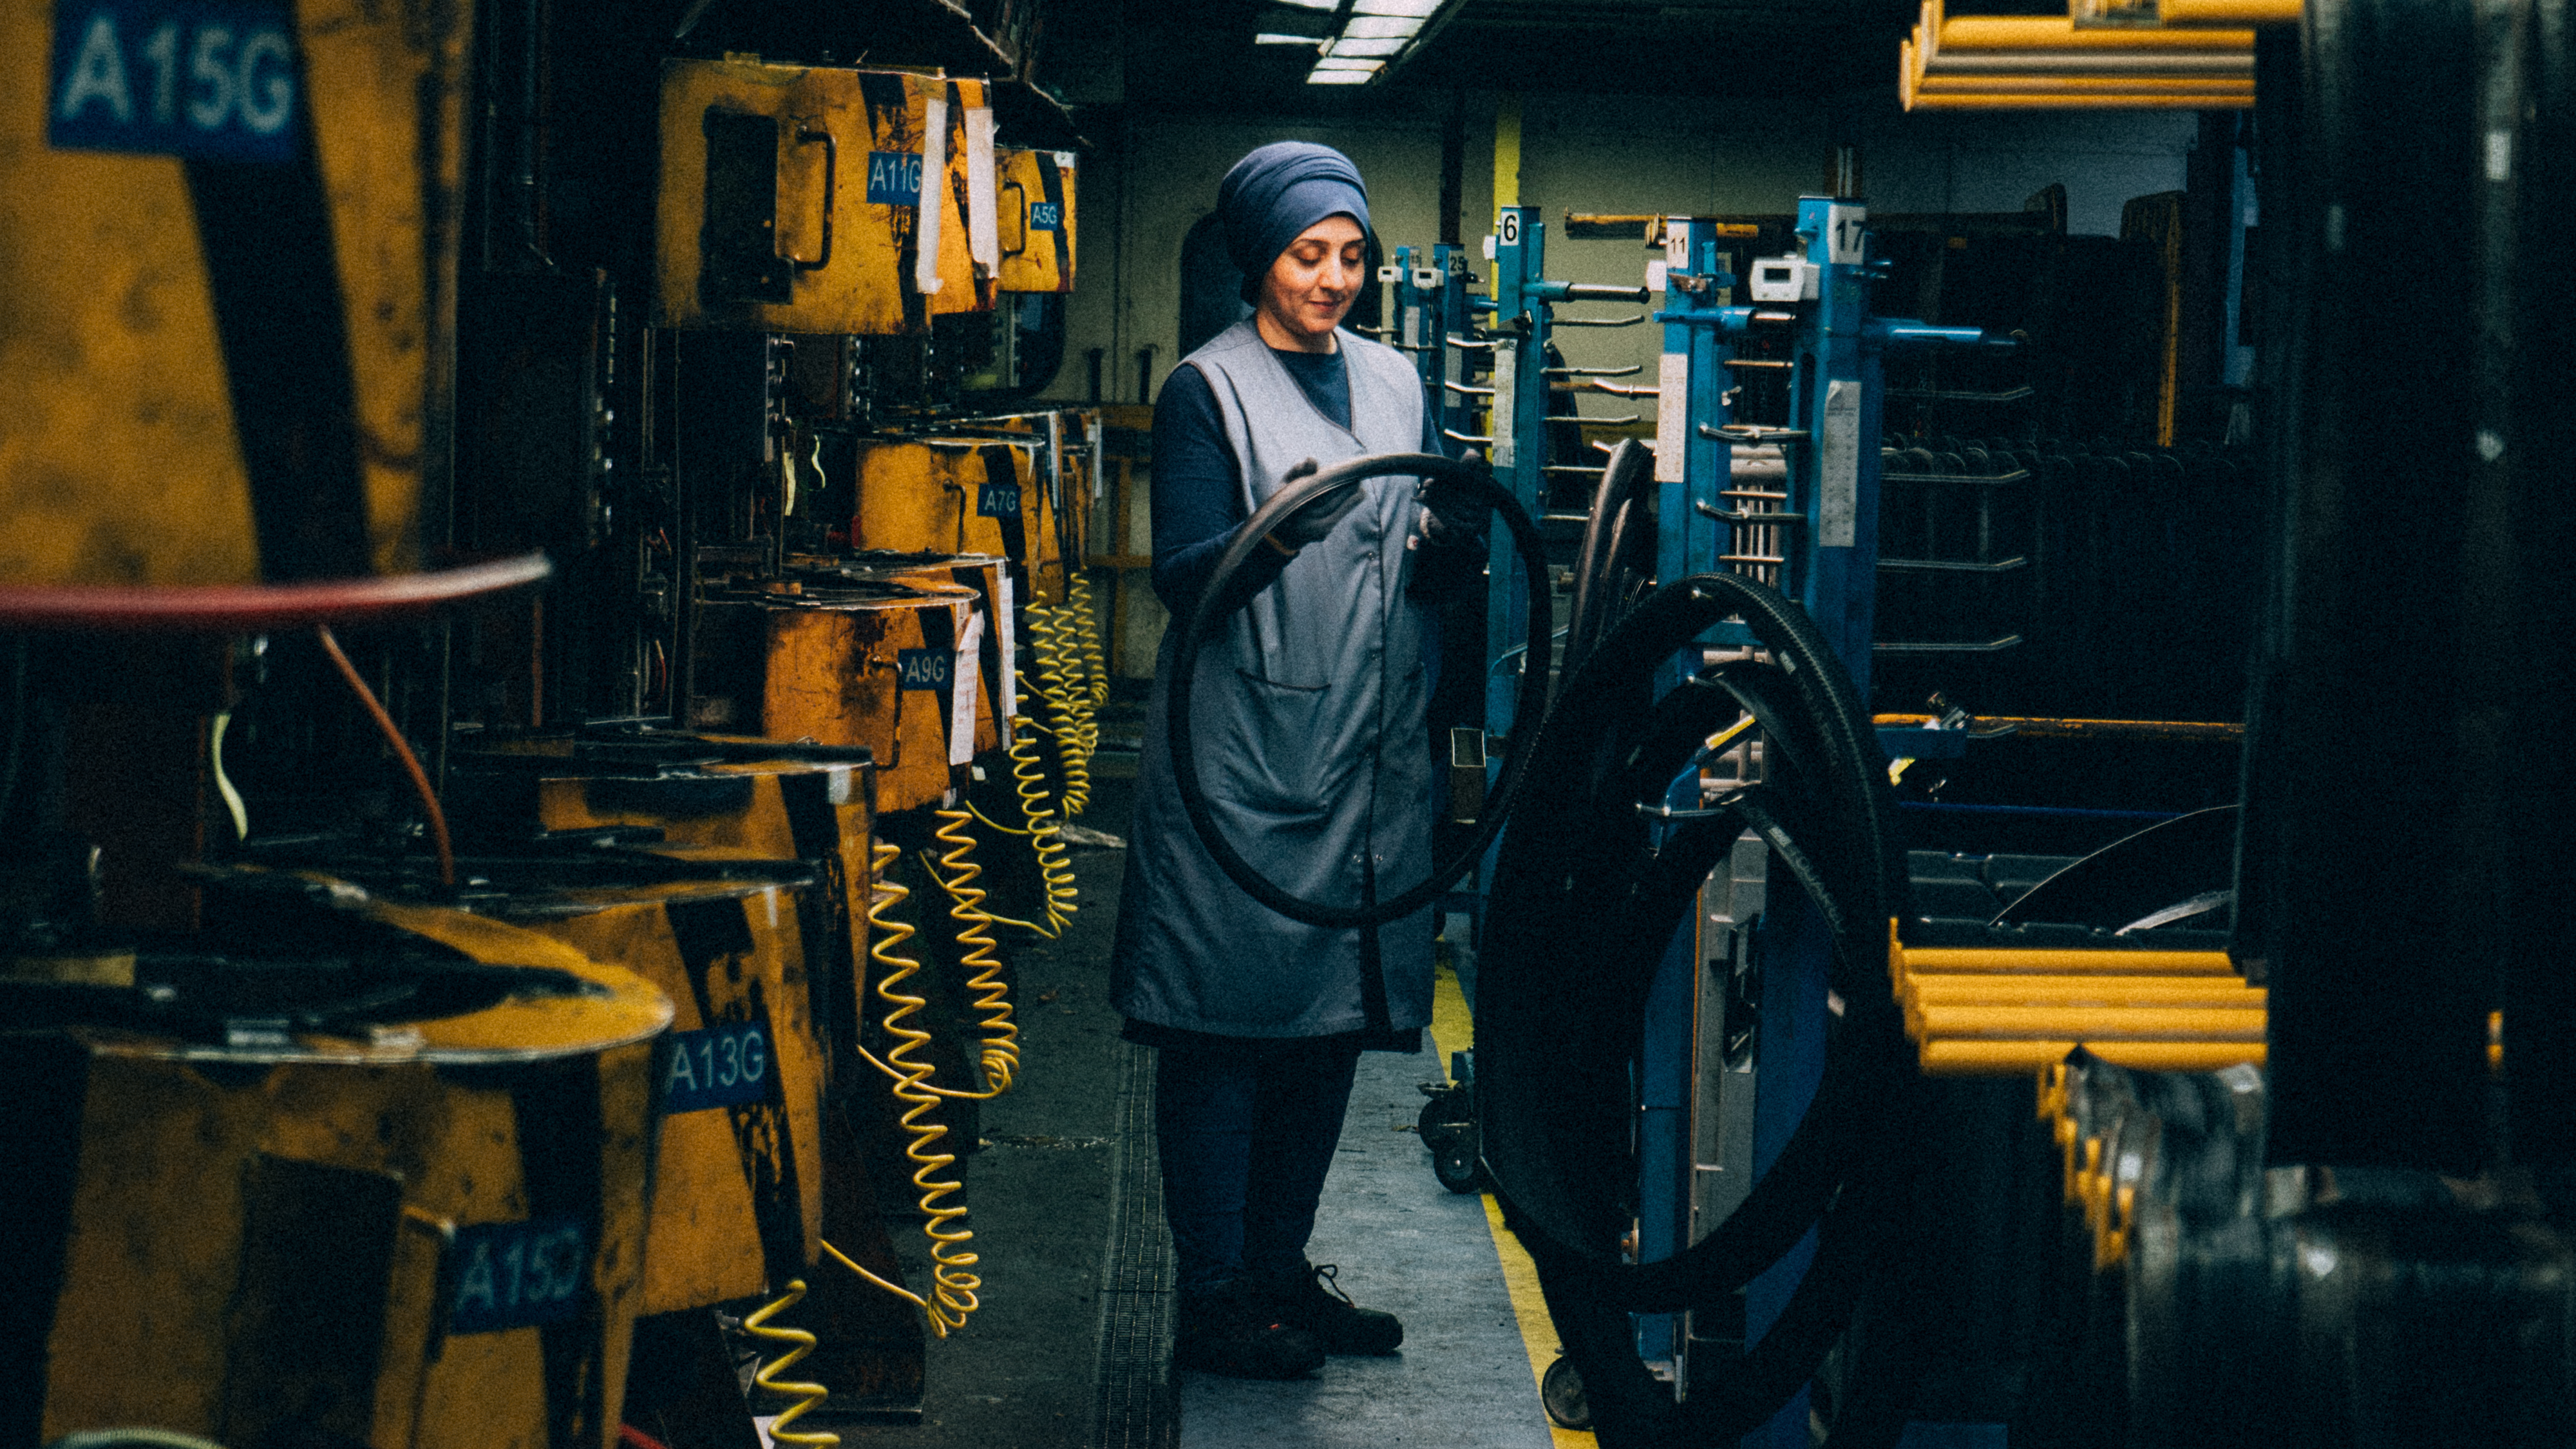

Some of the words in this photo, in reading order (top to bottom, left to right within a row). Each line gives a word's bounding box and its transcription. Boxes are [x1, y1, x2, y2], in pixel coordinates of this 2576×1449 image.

[61, 16, 295, 136] A15G
[869, 158, 921, 193] A11G
[1032, 205, 1057, 225] A5G
[1504, 214, 1517, 242] 6
[1671, 238, 1685, 254] 11
[1836, 219, 1866, 252] 17
[1450, 256, 1464, 271] 25
[984, 490, 1016, 512] A7G
[905, 656, 945, 683] A9G
[665, 1030, 765, 1096] A13G
